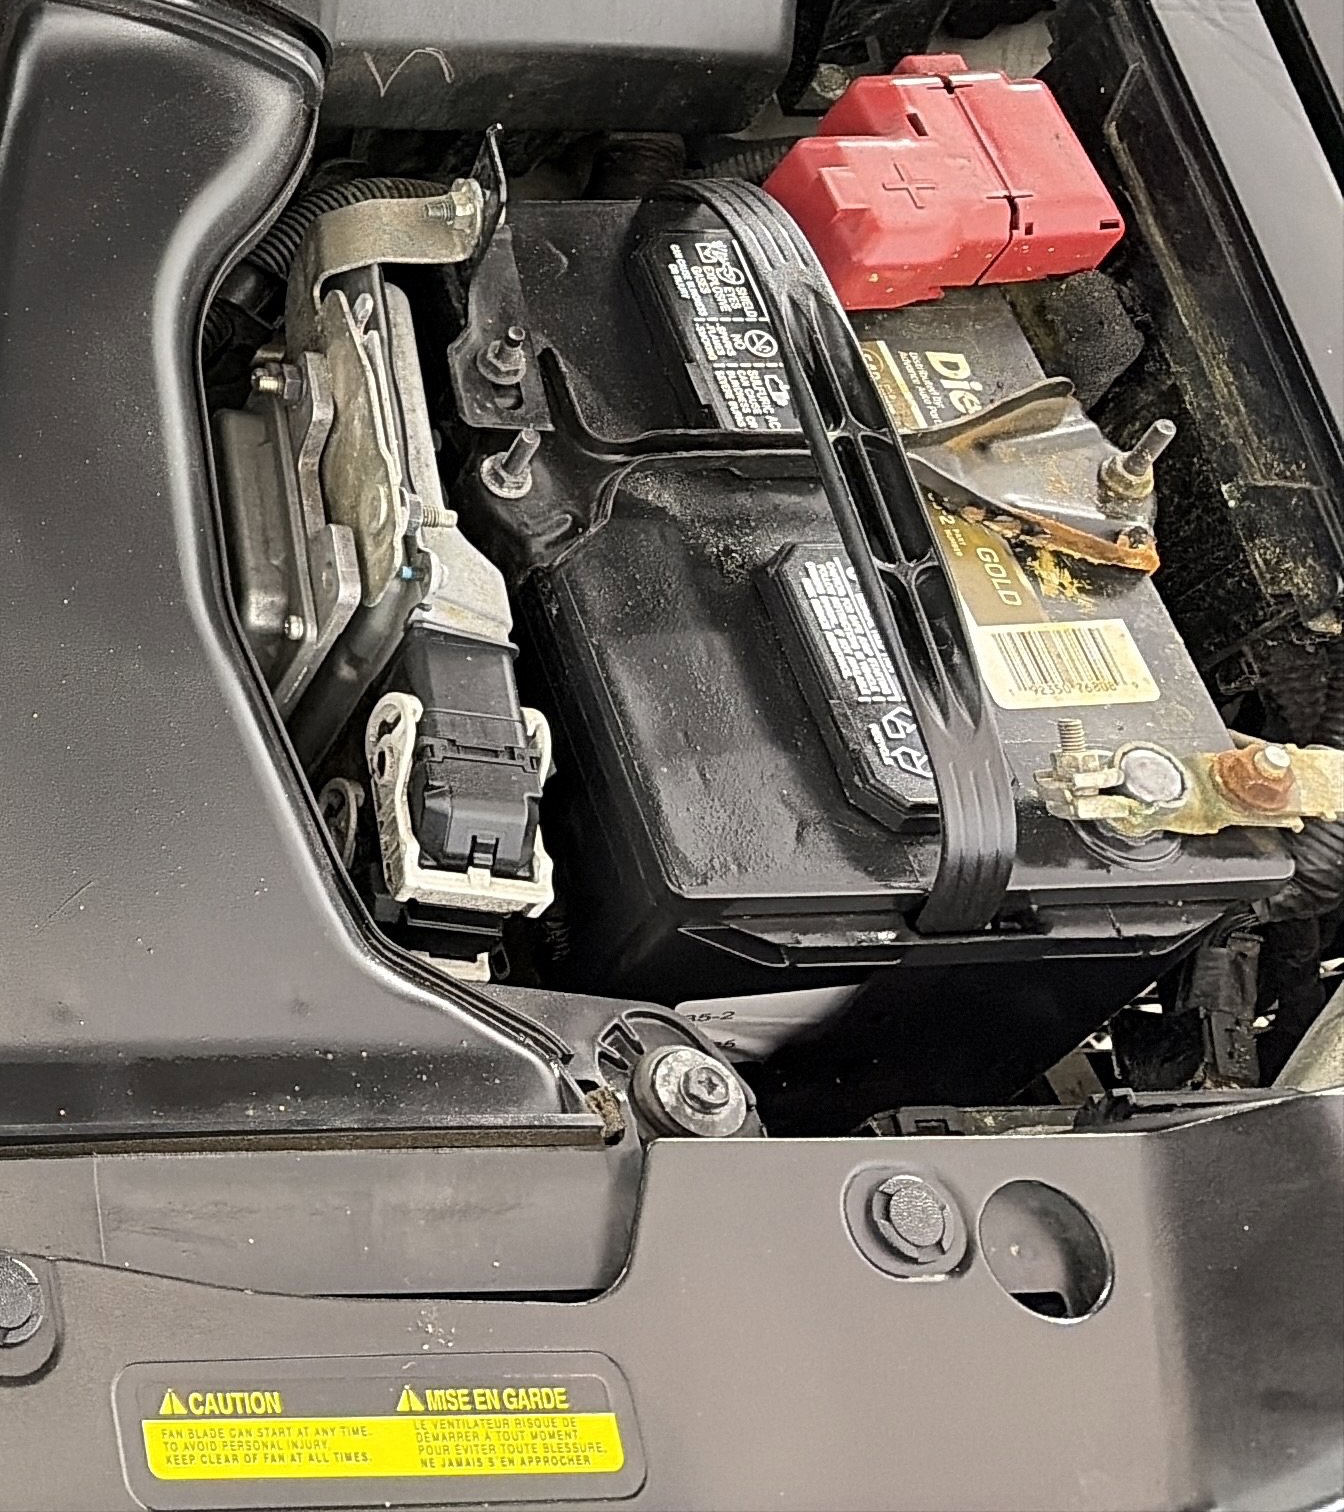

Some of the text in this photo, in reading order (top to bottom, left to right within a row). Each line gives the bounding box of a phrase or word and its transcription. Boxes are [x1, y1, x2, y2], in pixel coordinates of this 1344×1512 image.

[690, 266, 712, 294] GASES
[703, 266, 731, 312] EXPLOSIVE
[722, 287, 740, 309] EYES
[735, 287, 757, 317] SHIELD
[730, 335, 747, 349] NO
[736, 370, 762, 415] CAN CAUSE
[925, 352, 983, 414] Die
[746, 370, 781, 429] SULFURIC AC
[976, 549, 1022, 604] GOLD
[1077, 681, 1118, 694] 76808
[188, 1391, 282, 1415] CAUTION
[425, 1388, 569, 1412] MISE EN GARDE
[162, 1429, 182, 1439] FAN
[188, 1428, 224, 1438] BLADE
[230, 1427, 252, 1438] CAN
[257, 1427, 291, 1437] START
[297, 1426, 308, 1437] AT
[314, 1426, 336, 1437] ANY
[415, 1417, 577, 1429] LE VENTILATEUR RISQUE DE
[163, 1442, 178, 1452] TO
[183, 1441, 217, 1451] AVOID
[222, 1440, 283, 1451] PERSONAL
[496, 1430, 525, 1441] TOUT
[166, 1454, 195, 1465] KEEP
[202, 1453, 239, 1464] CLEAR
[244, 1453, 257, 1464] OF
[264, 1452, 285, 1463] FAN
[290, 1452, 302, 1463] AT
[308, 1452, 329, 1463] ALL
[419, 1444, 450, 1455] POUR
[500, 1444, 538, 1454] TOUTE
[421, 1457, 436, 1468] NE
[441, 1457, 483, 1467] JAMAIS
